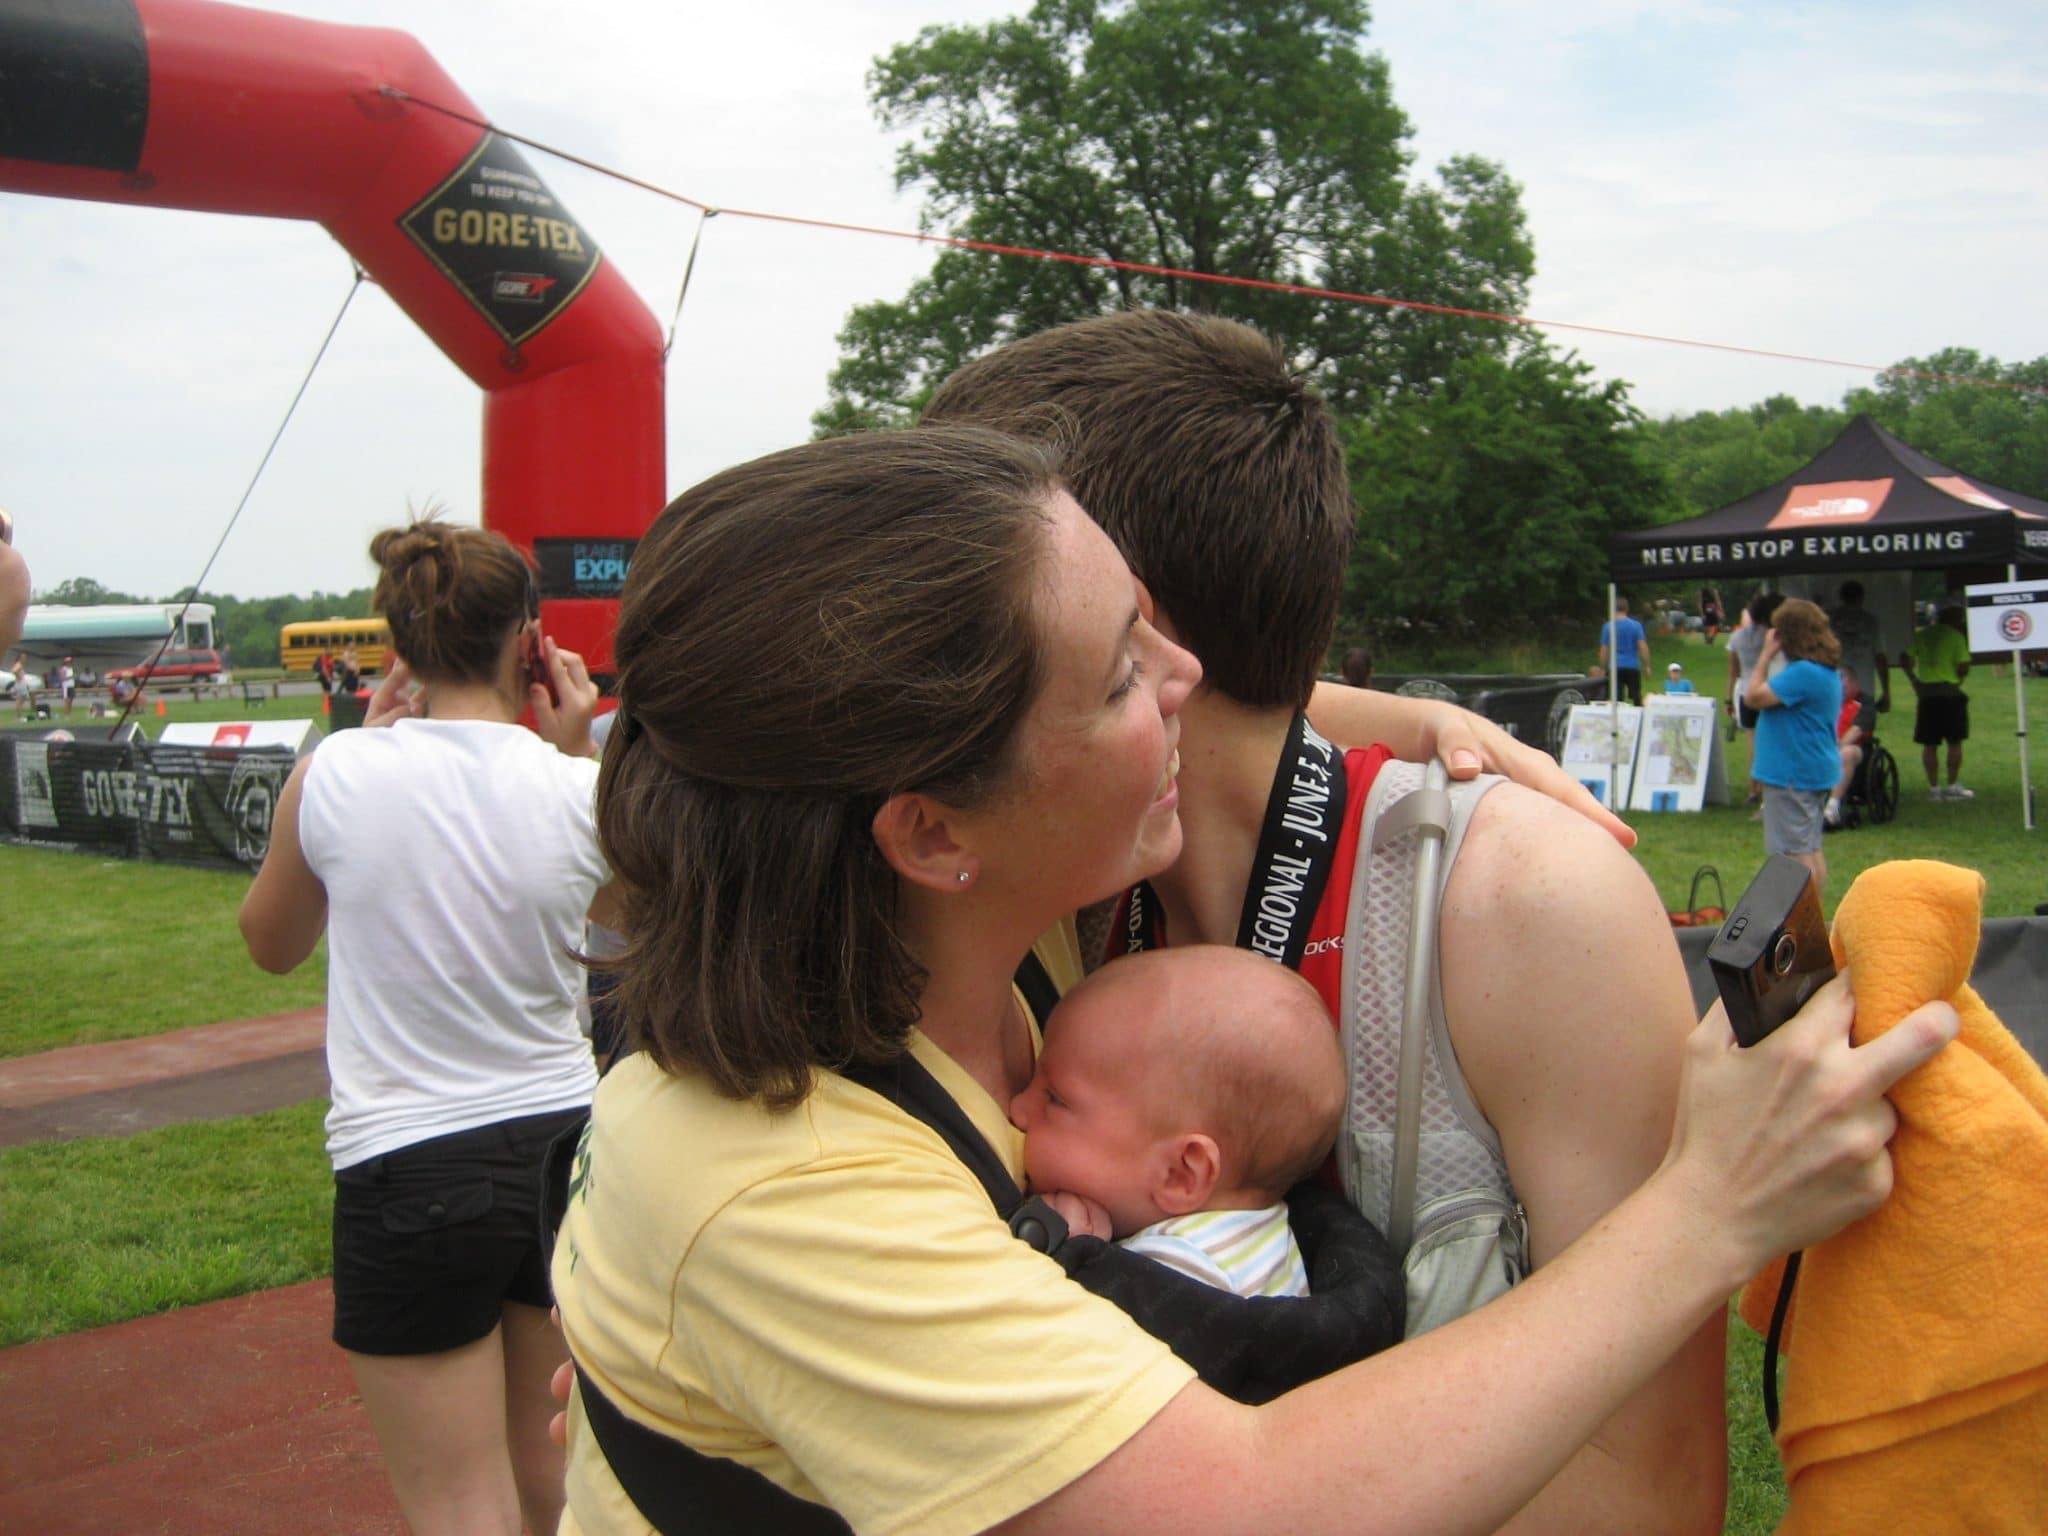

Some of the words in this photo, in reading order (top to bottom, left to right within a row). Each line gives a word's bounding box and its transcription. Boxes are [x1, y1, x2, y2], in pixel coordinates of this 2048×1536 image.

[433, 208, 585, 253] GORE-TEX
[575, 559, 630, 580] EXPL
[1642, 546, 1721, 565] NEVER
[1731, 540, 1795, 560] STOP
[1281, 774, 1331, 842] JUNE
